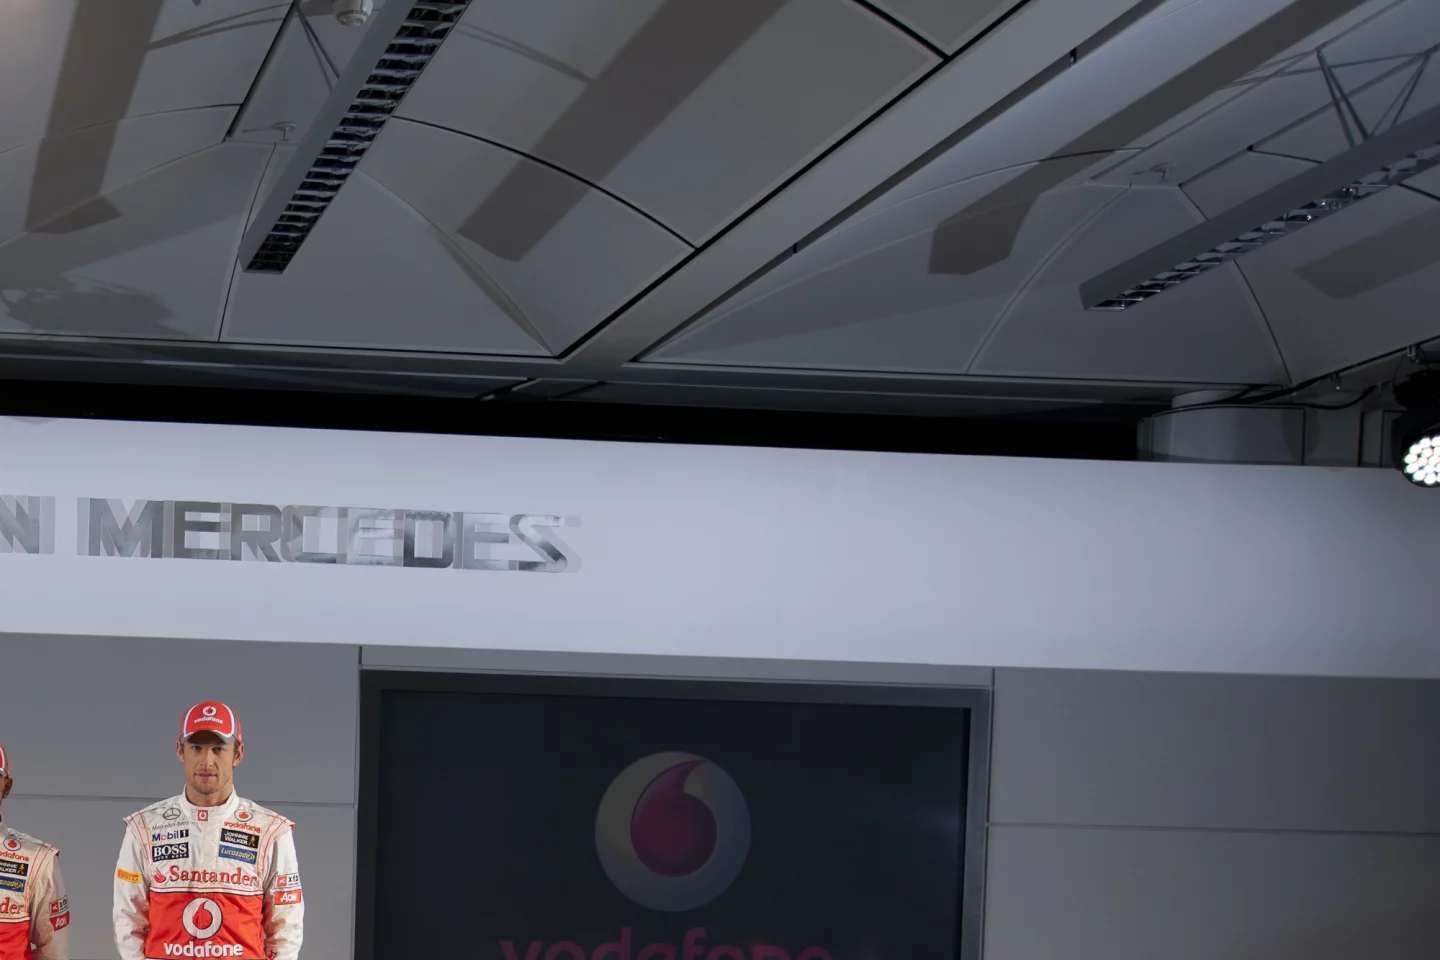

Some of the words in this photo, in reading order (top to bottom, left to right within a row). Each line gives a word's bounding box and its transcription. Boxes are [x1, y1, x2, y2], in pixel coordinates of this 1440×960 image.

[88, 497, 568, 573] MERCEDES
[194, 716, 224, 725] vodafone
[224, 821, 260, 833] vodafone
[152, 830, 179, 842] Mobil
[153, 844, 188, 858] BOSS
[169, 865, 257, 887] Santander
[164, 940, 244, 958] vodafone
